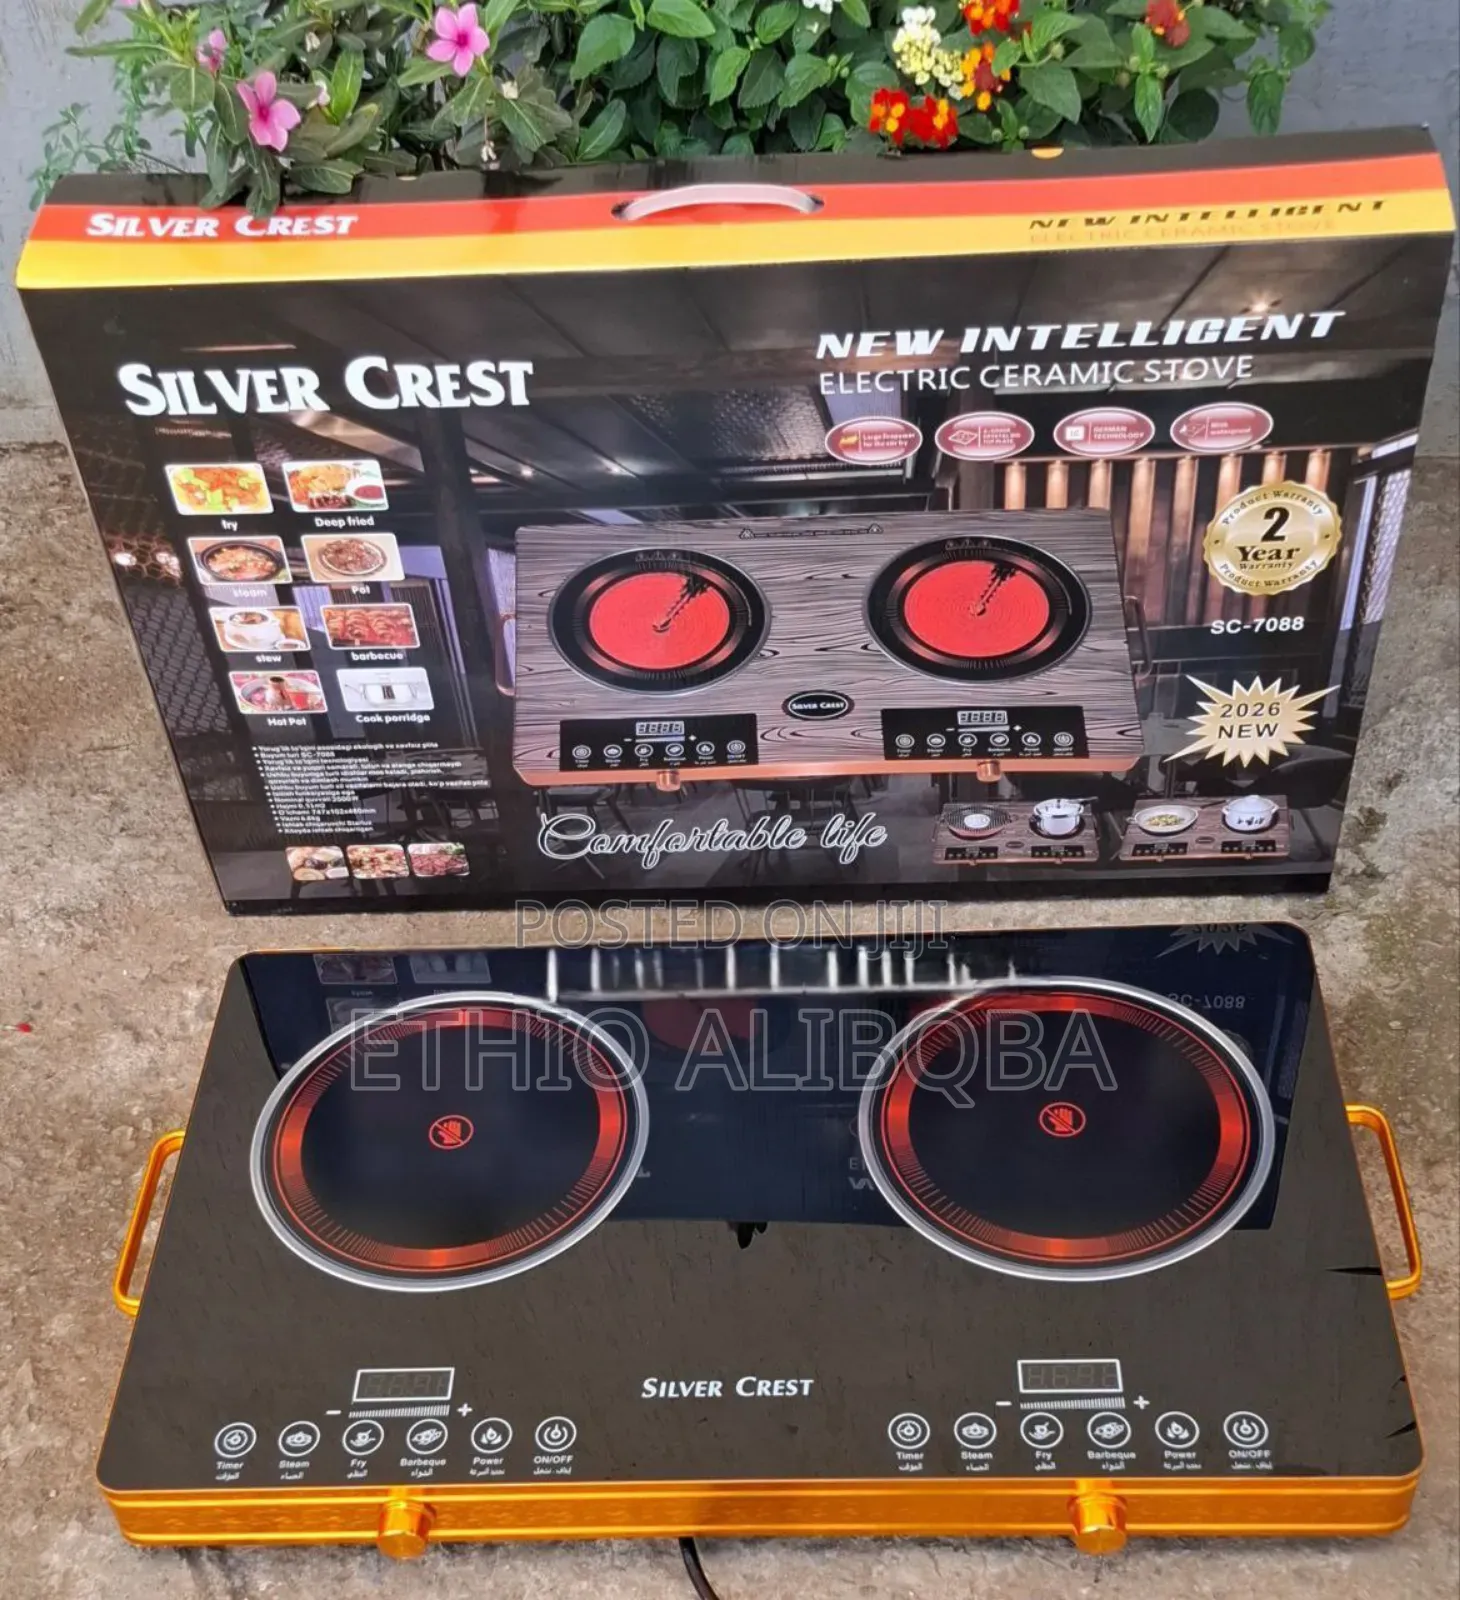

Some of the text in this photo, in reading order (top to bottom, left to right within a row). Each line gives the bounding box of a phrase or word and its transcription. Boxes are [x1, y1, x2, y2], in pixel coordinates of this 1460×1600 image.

[87, 213, 358, 238] SILVER CREST
[816, 311, 1345, 359] NEW INTELLIGENT
[117, 356, 534, 416] SILVER CREST
[820, 355, 1254, 395] ELECTRIC CERAMIC STOVE
[1222, 490, 1324, 525] Product Warranty
[315, 517, 344, 528] Deep
[1260, 506, 1290, 542] 2
[1235, 545, 1301, 562] Year
[1220, 559, 1317, 587] Product Warranty
[1239, 561, 1293, 570] Warranty
[1210, 616, 1305, 635] SC-7088
[1220, 702, 1281, 718] 2026
[1218, 723, 1279, 740] NEW
[537, 812, 888, 869] Comfortable life
[641, 1376, 815, 1398] SILVER CREST
[216, 1455, 573, 1470] Timer Steam Fry Barbeque Power ON/OFF
[896, 1450, 1271, 1461] Timer Steam Fry Barbeque Power ON/OFF
